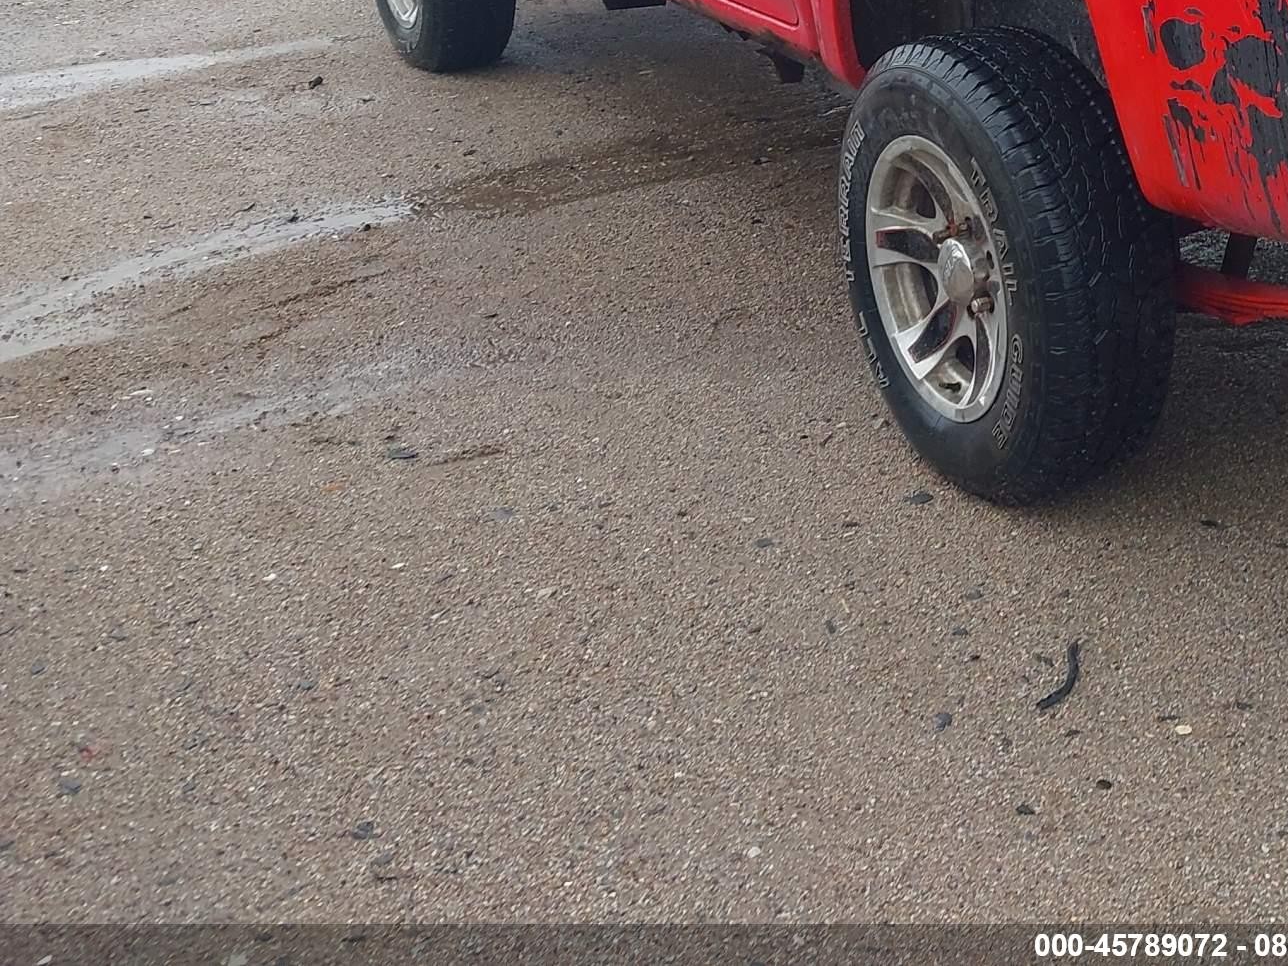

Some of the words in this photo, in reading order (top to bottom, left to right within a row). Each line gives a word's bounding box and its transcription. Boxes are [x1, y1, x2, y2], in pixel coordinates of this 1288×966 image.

[839, 120, 867, 282] TERRAIN
[970, 156, 1018, 306] TRAIL
[991, 333, 1024, 450] GUIDE
